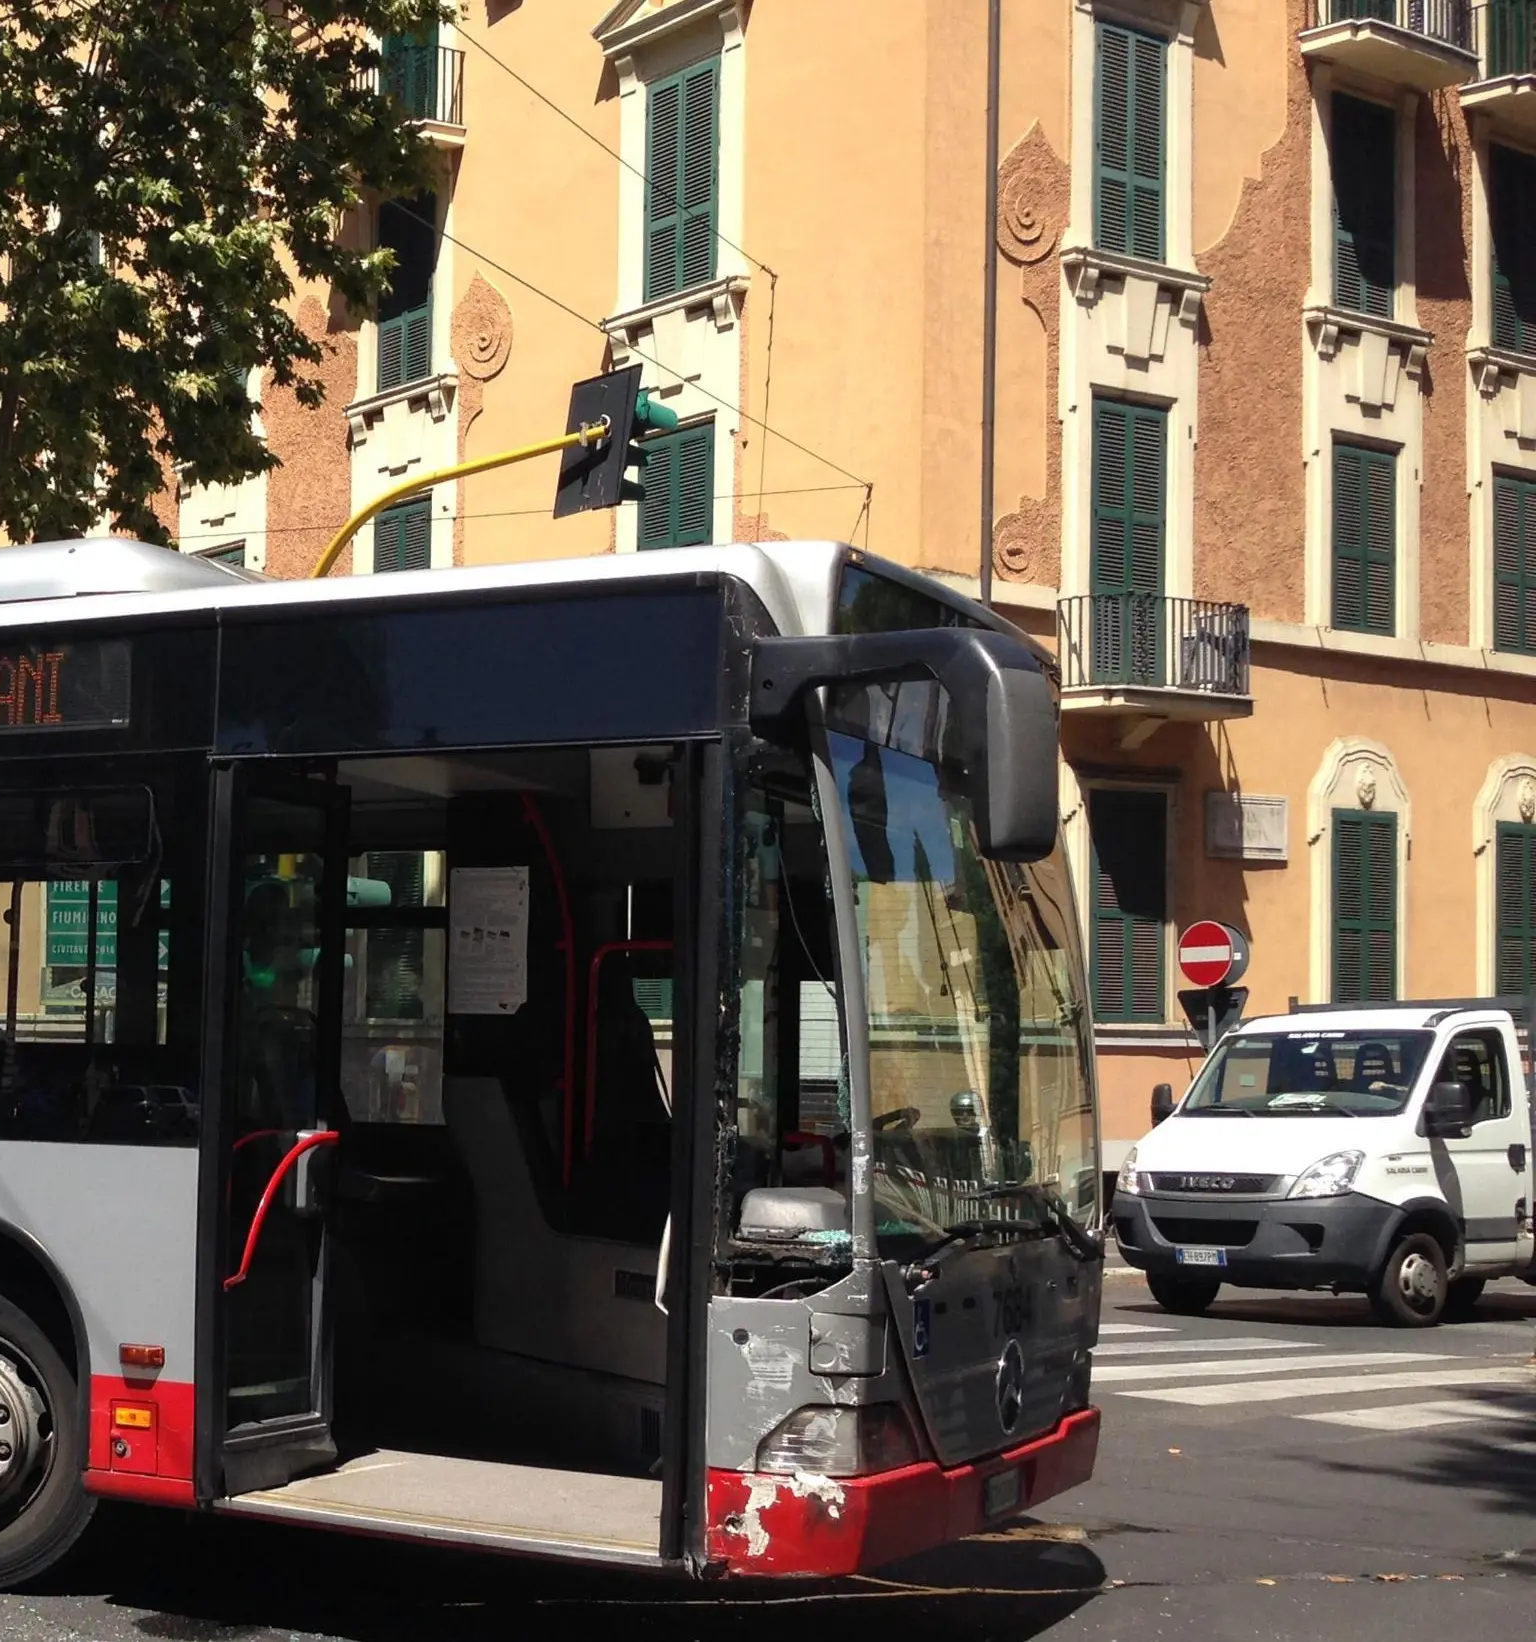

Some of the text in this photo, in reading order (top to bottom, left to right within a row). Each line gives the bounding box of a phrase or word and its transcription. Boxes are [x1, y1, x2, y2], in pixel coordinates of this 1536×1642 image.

[53, 881, 105, 893] FIRENE
[52, 911, 117, 924] FIUMIINO
[1179, 1175, 1236, 1190] IVECO
